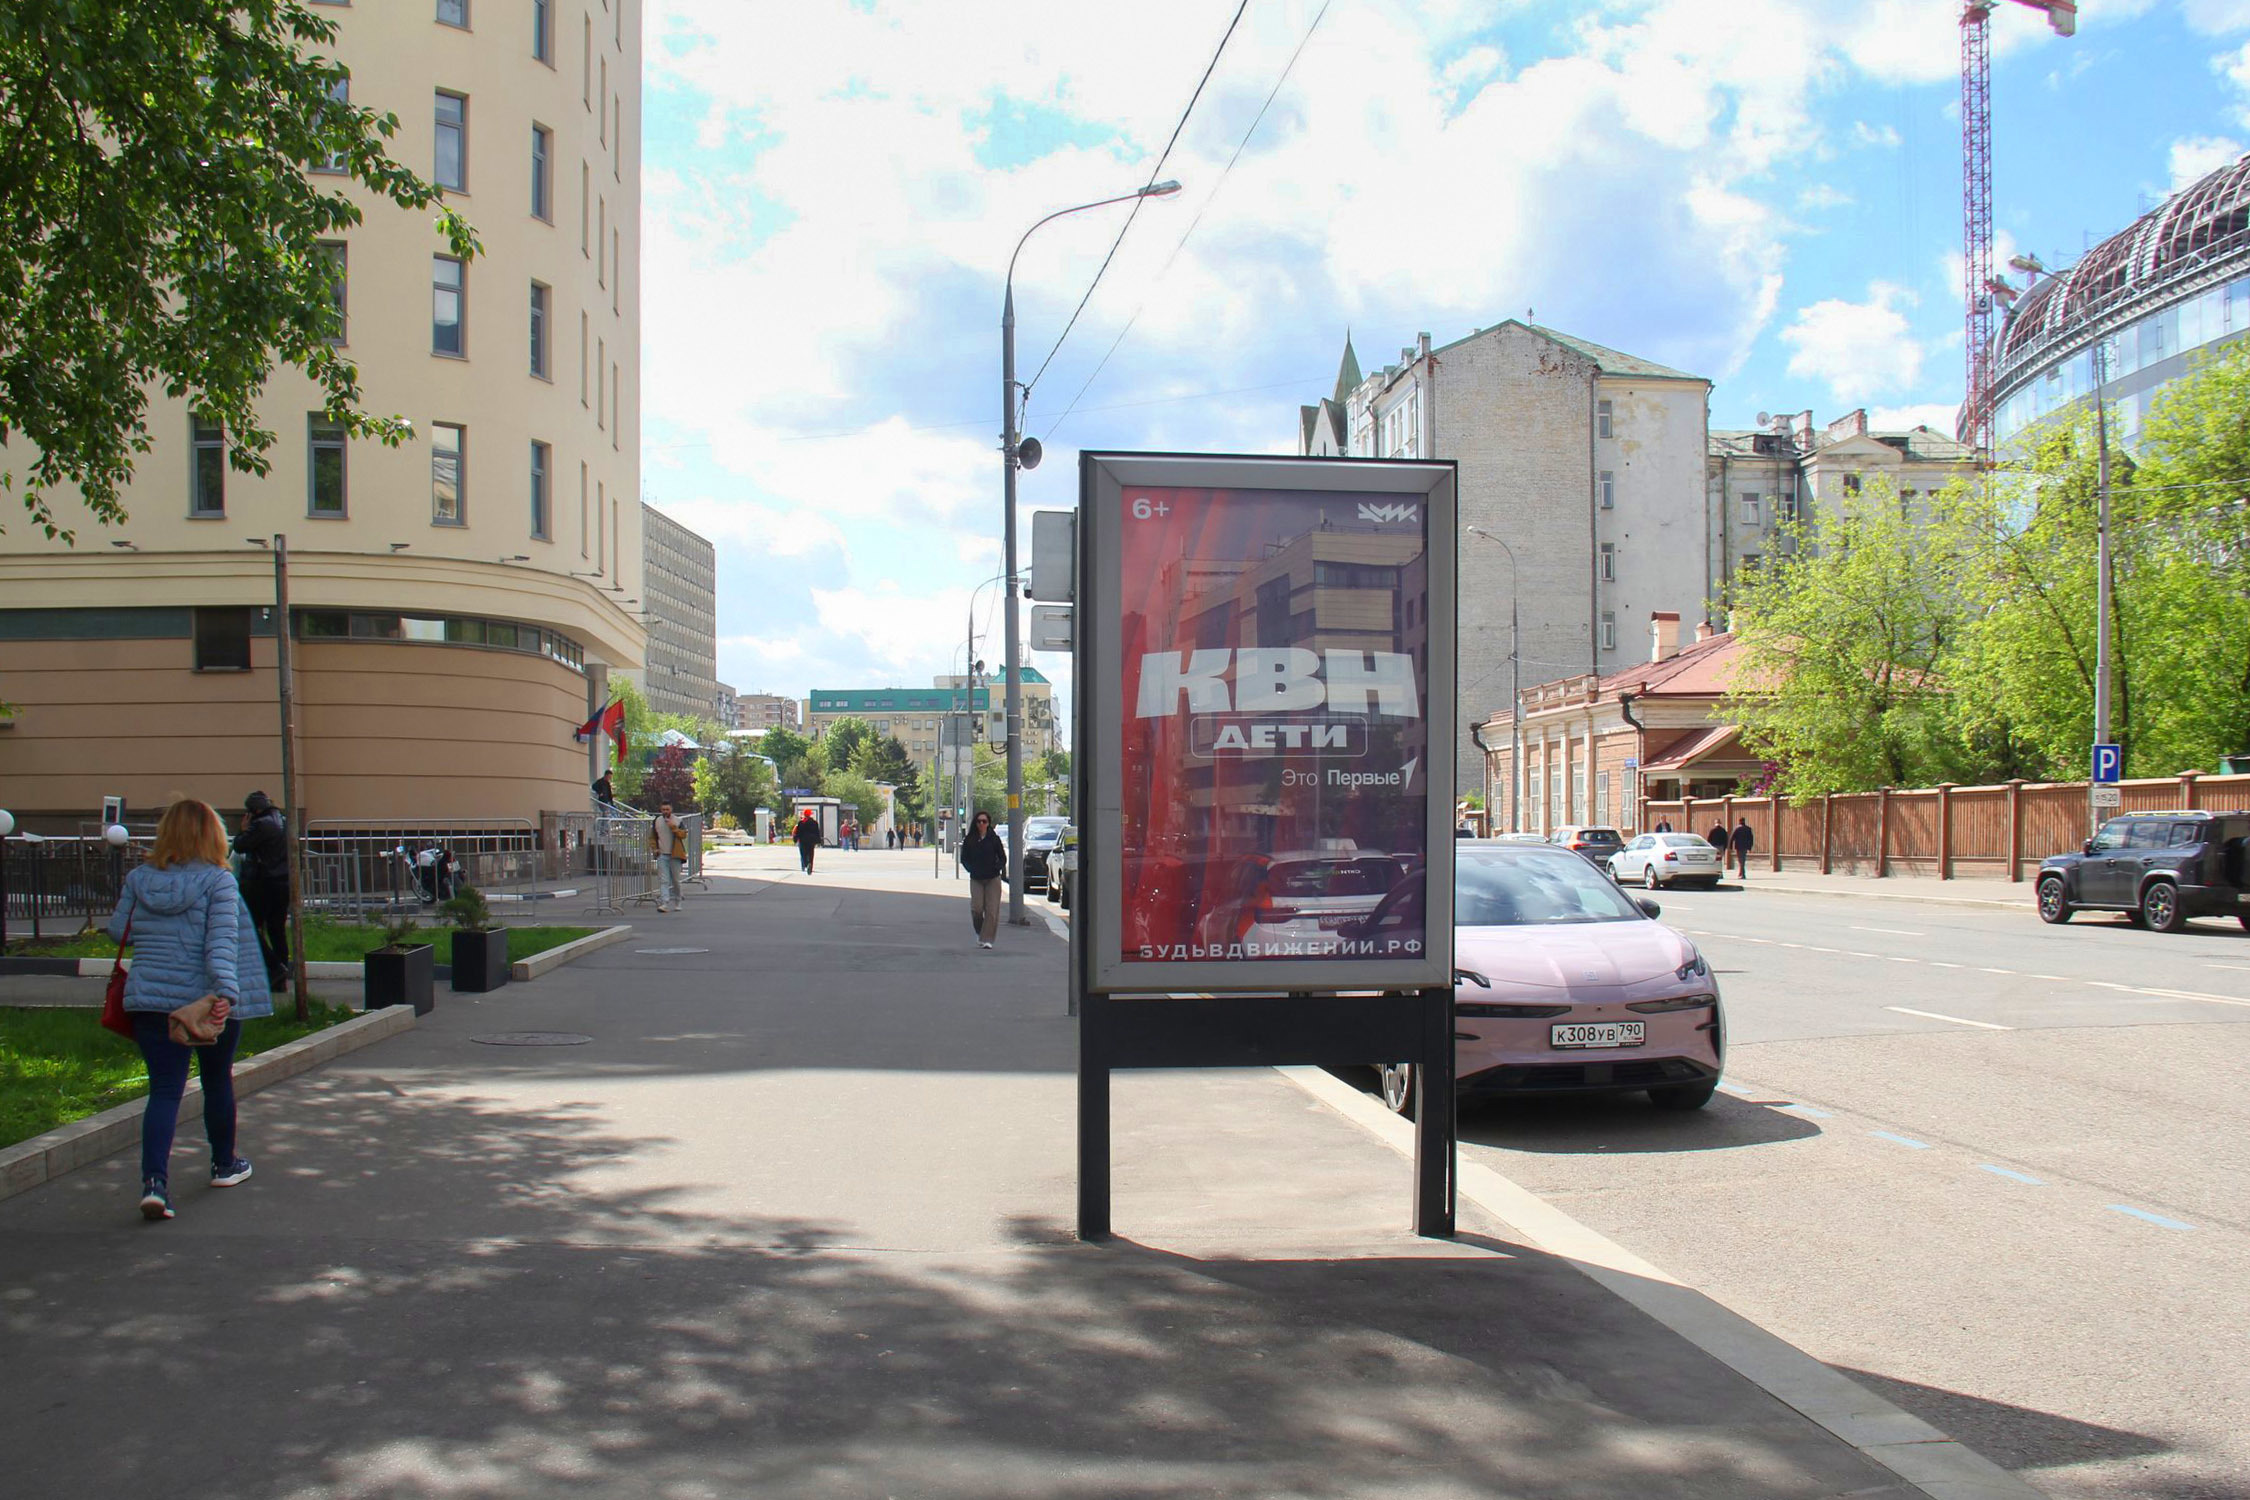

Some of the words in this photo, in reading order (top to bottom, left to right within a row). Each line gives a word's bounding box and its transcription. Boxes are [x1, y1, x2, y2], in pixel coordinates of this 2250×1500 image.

[1132, 498, 1169, 519] 6+
[1135, 647, 1420, 718] КВН
[1213, 724, 1347, 750] ДЕТИ
[2100, 749, 2116, 779] P
[1281, 769, 1318, 787] Это
[1327, 769, 1400, 790] Первые
[1139, 939, 1422, 960] БУДЬВДВИЖЕНИИ.РФ
[1557, 1026, 1616, 1042] К308УВ
[1619, 1023, 1641, 1036] 790
